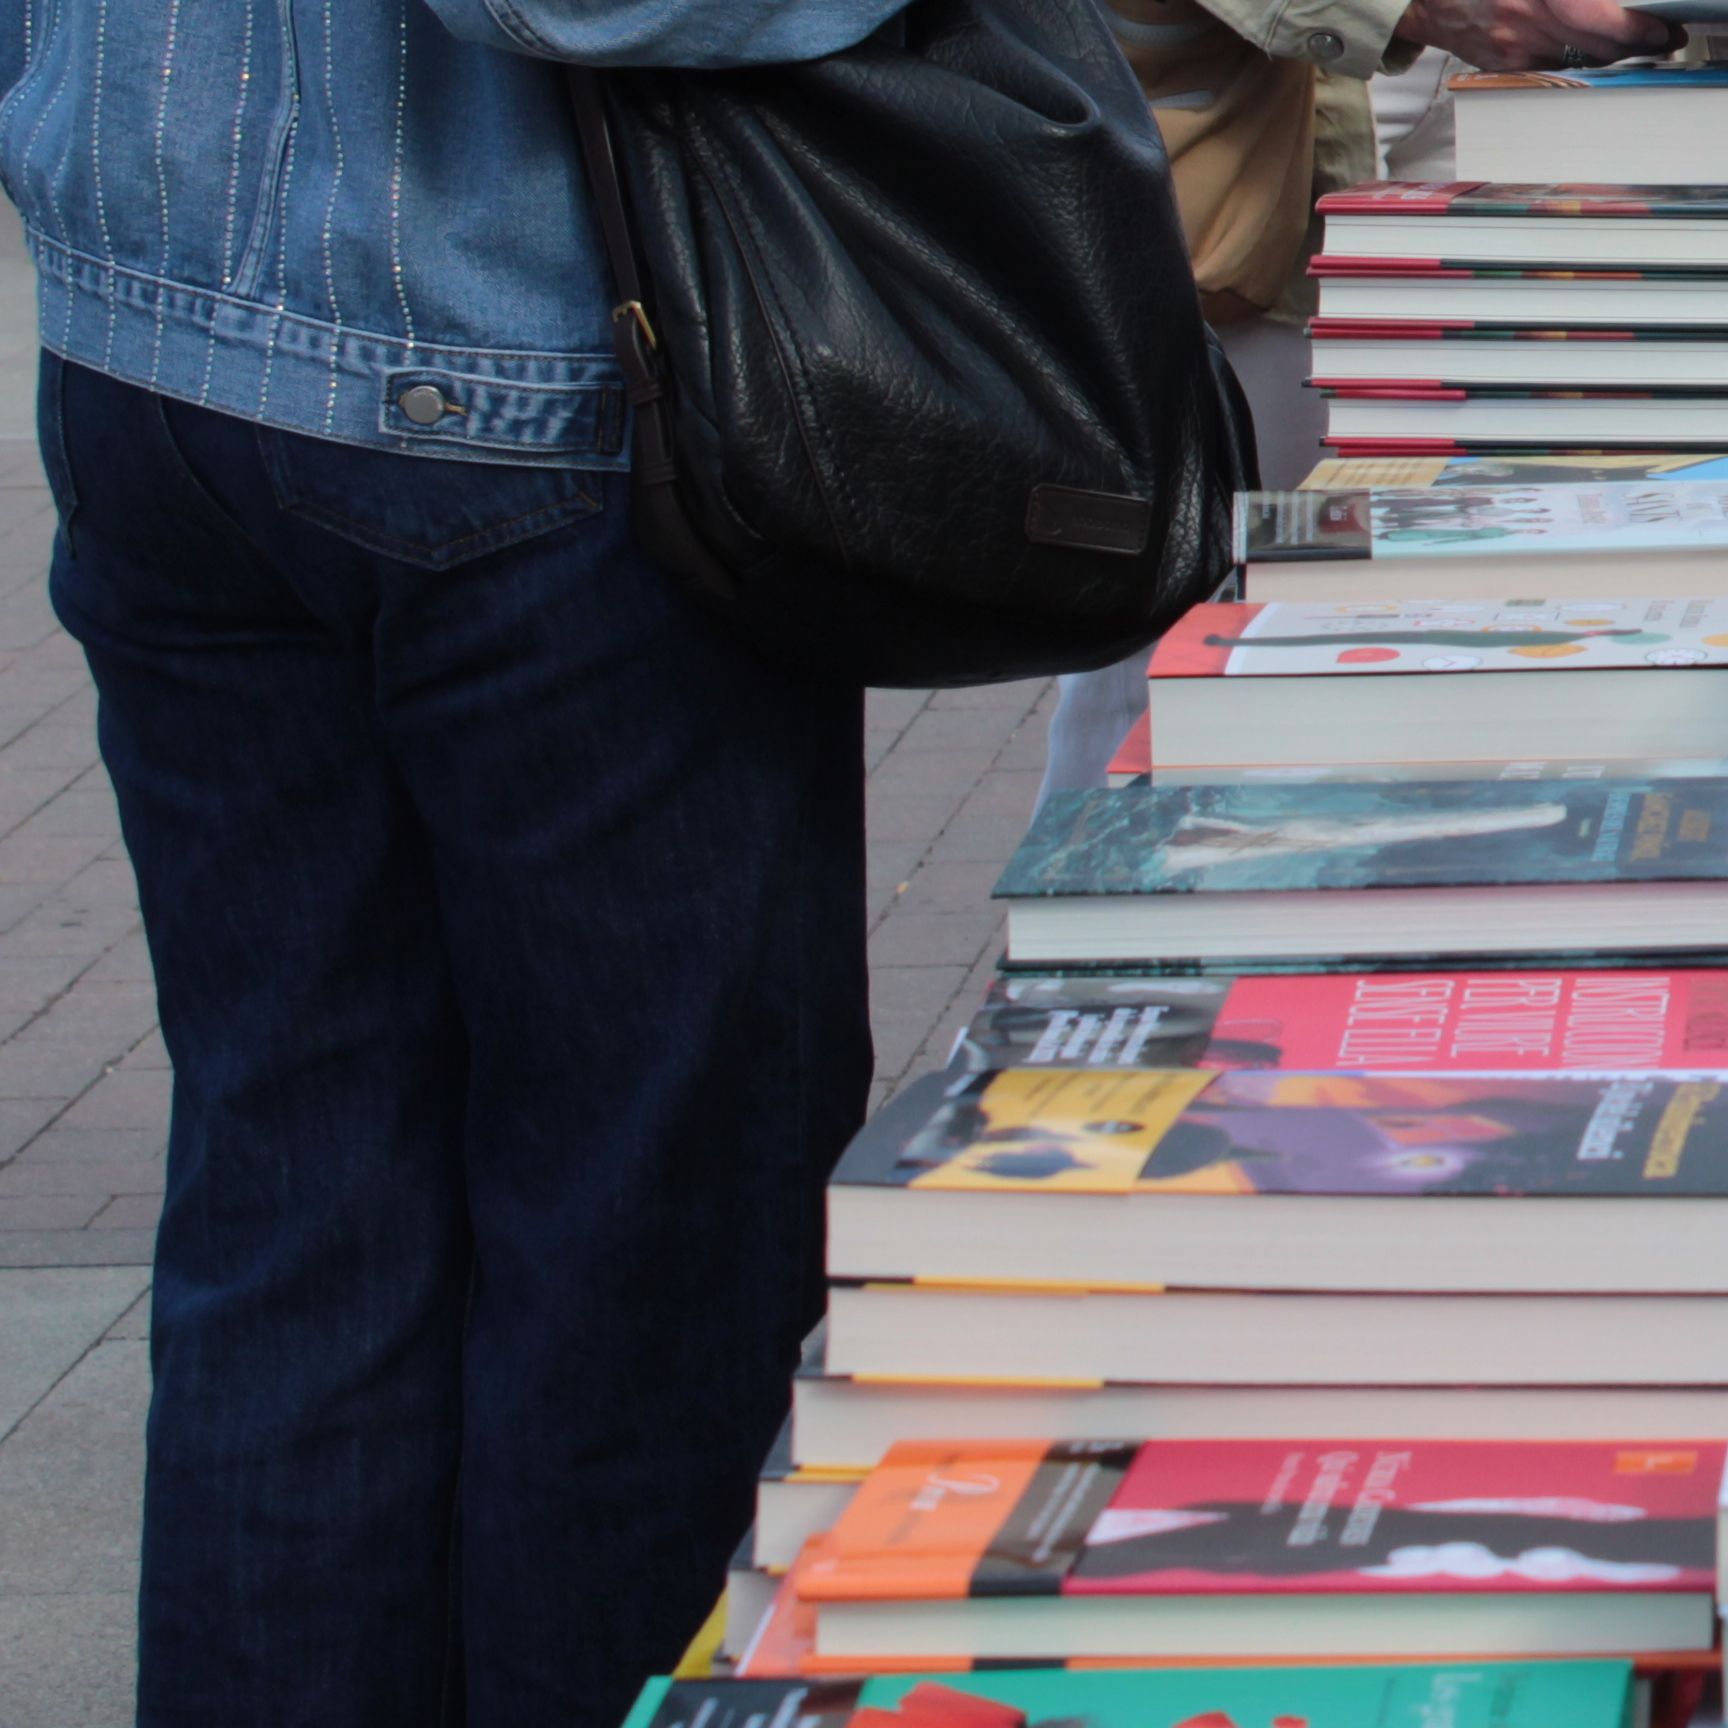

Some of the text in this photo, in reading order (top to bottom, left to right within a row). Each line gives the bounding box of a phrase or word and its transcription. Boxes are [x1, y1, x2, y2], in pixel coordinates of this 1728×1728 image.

[1336, 979, 1456, 1067] SENSE ELLA
[1451, 978, 1561, 1059] PER VIURE
[1562, 976, 1672, 1070] INSTRUCCION
